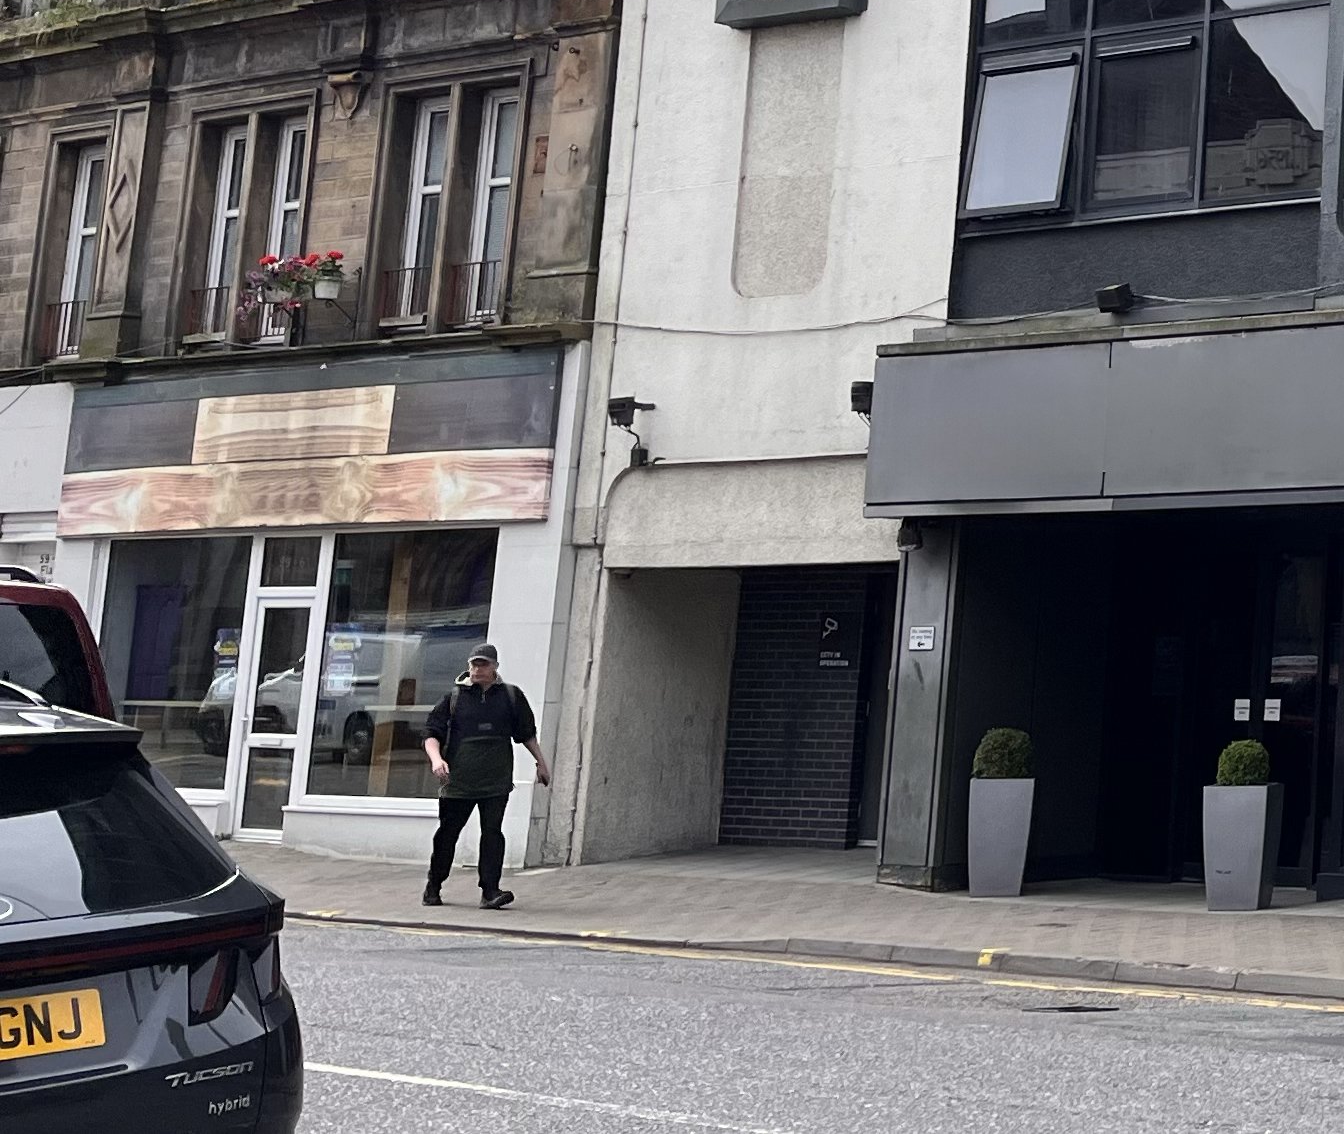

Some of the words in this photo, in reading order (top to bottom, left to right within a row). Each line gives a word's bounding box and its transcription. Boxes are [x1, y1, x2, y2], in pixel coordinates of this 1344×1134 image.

[0, 997, 82, 1049] GNJ
[165, 1060, 254, 1088] TUCSON
[208, 1093, 251, 1116] hybrid
